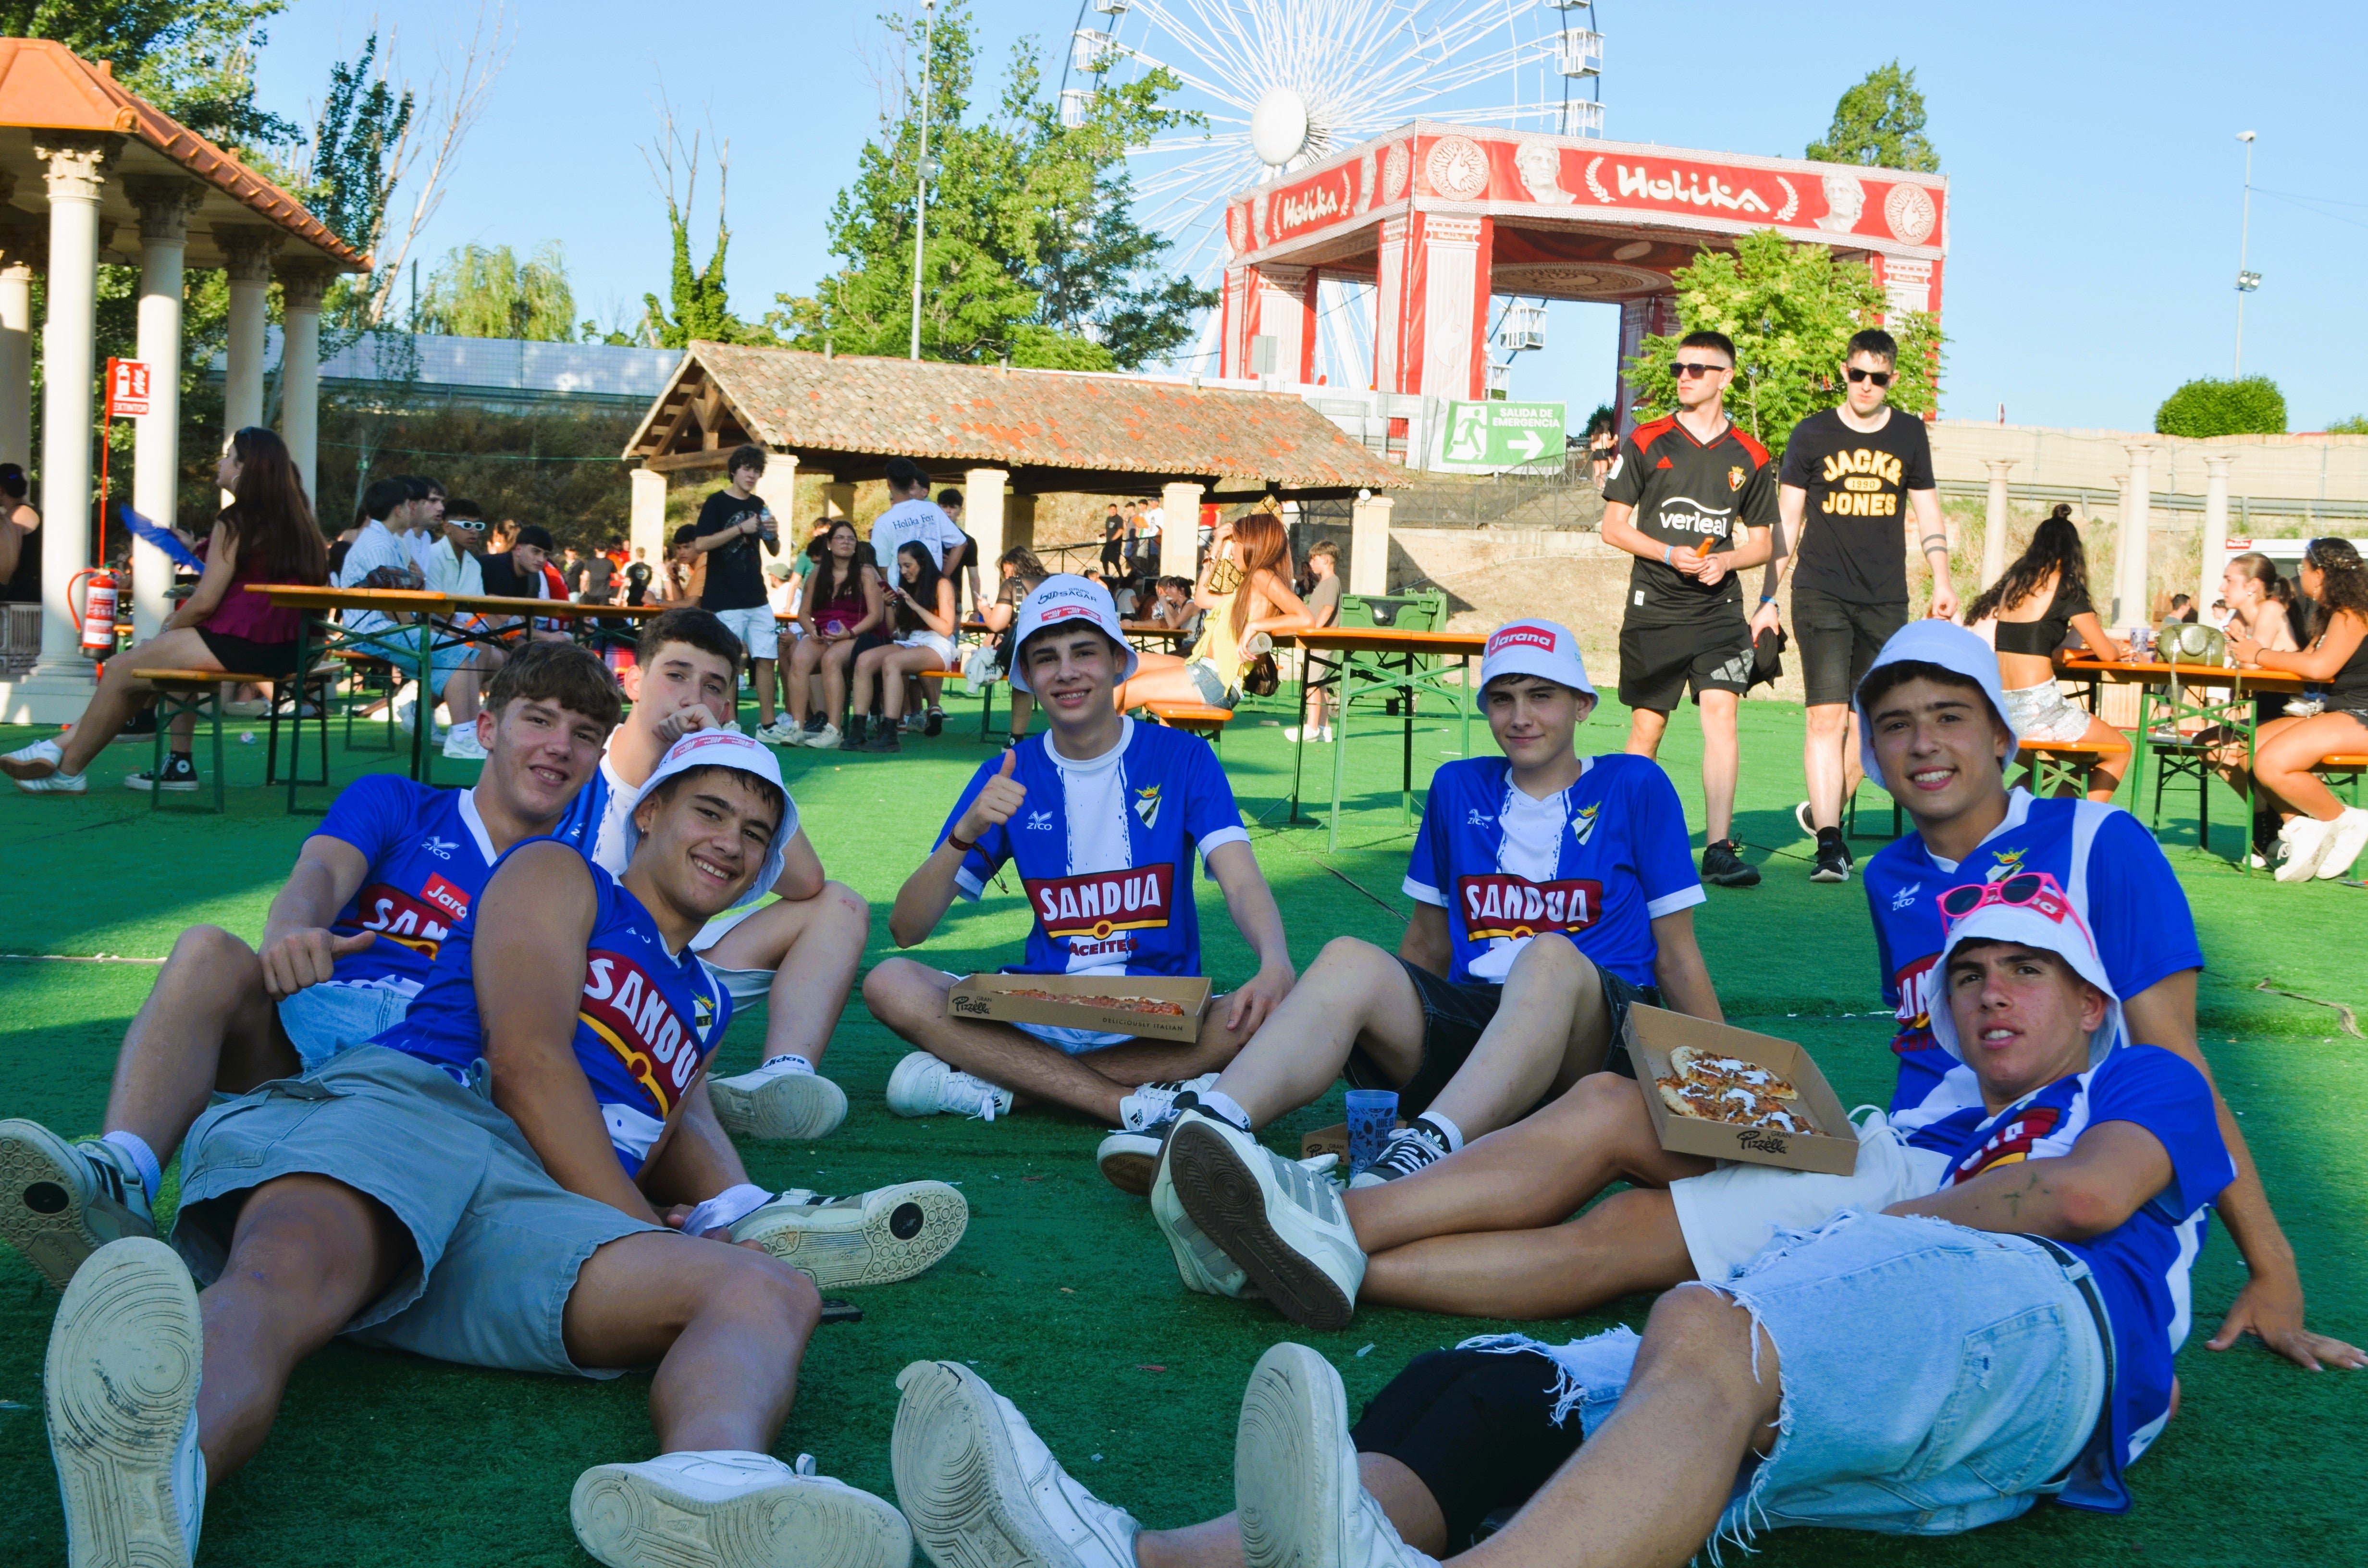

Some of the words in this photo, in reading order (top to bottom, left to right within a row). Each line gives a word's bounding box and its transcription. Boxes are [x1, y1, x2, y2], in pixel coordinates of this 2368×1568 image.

[1616, 163, 1771, 213] Holika
[1283, 185, 1338, 230] Holika
[113, 402, 149, 413] EXTINTOR
[1500, 407, 1538, 417] SALIDA
[1540, 409, 1553, 418] DE
[1492, 416, 1560, 428] EMERGENCIA
[1851, 480, 1875, 489] 1990
[1822, 491, 1897, 516] JONES
[892, 517, 919, 529] Holika
[1659, 511, 1727, 538] verleal
[1491, 633, 1551, 650] Jarana
[1026, 822, 1052, 831] ZICO
[1467, 817, 1489, 829] ZICO
[421, 841, 451, 860] ZICO
[427, 884, 467, 919] Jara
[1040, 873, 1161, 921] SANDUA
[1466, 884, 1589, 923] SANDUA
[362, 898, 449, 941] SAN
[1069, 937, 1139, 956] ACEITES
[583, 958, 699, 1099] SANDU
[1102, 1017, 1150, 1028] DELICIOUSLY
[762, 1055, 805, 1069] didas
[1376, 1118, 1389, 1127] QUE
[1770, 1130, 1791, 1139] GRAN
